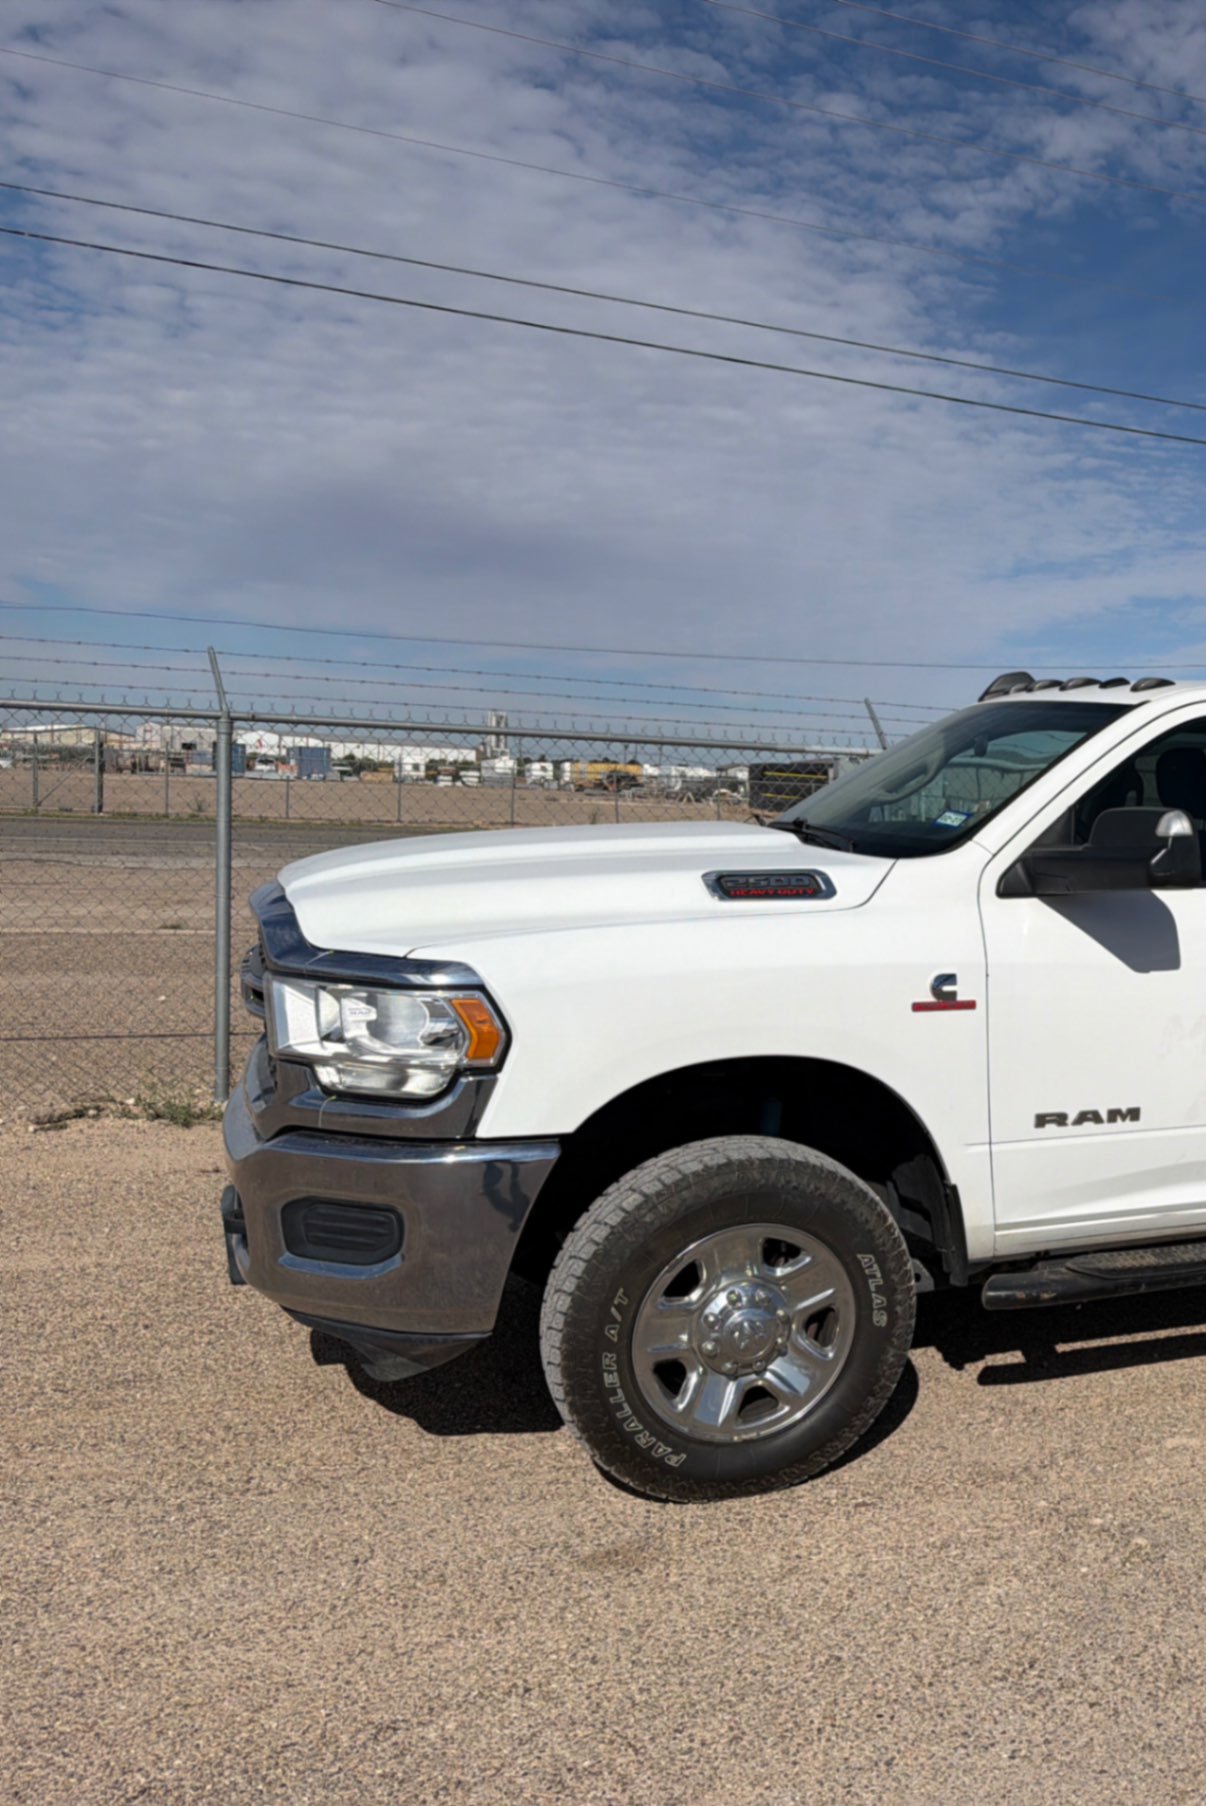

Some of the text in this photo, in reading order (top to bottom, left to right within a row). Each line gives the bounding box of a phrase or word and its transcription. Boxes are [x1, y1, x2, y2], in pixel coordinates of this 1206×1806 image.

[1034, 1106, 1141, 1128] RAM
[856, 1254, 887, 1327] ATLAS
[602, 1288, 687, 1467] PARALLER A/T
